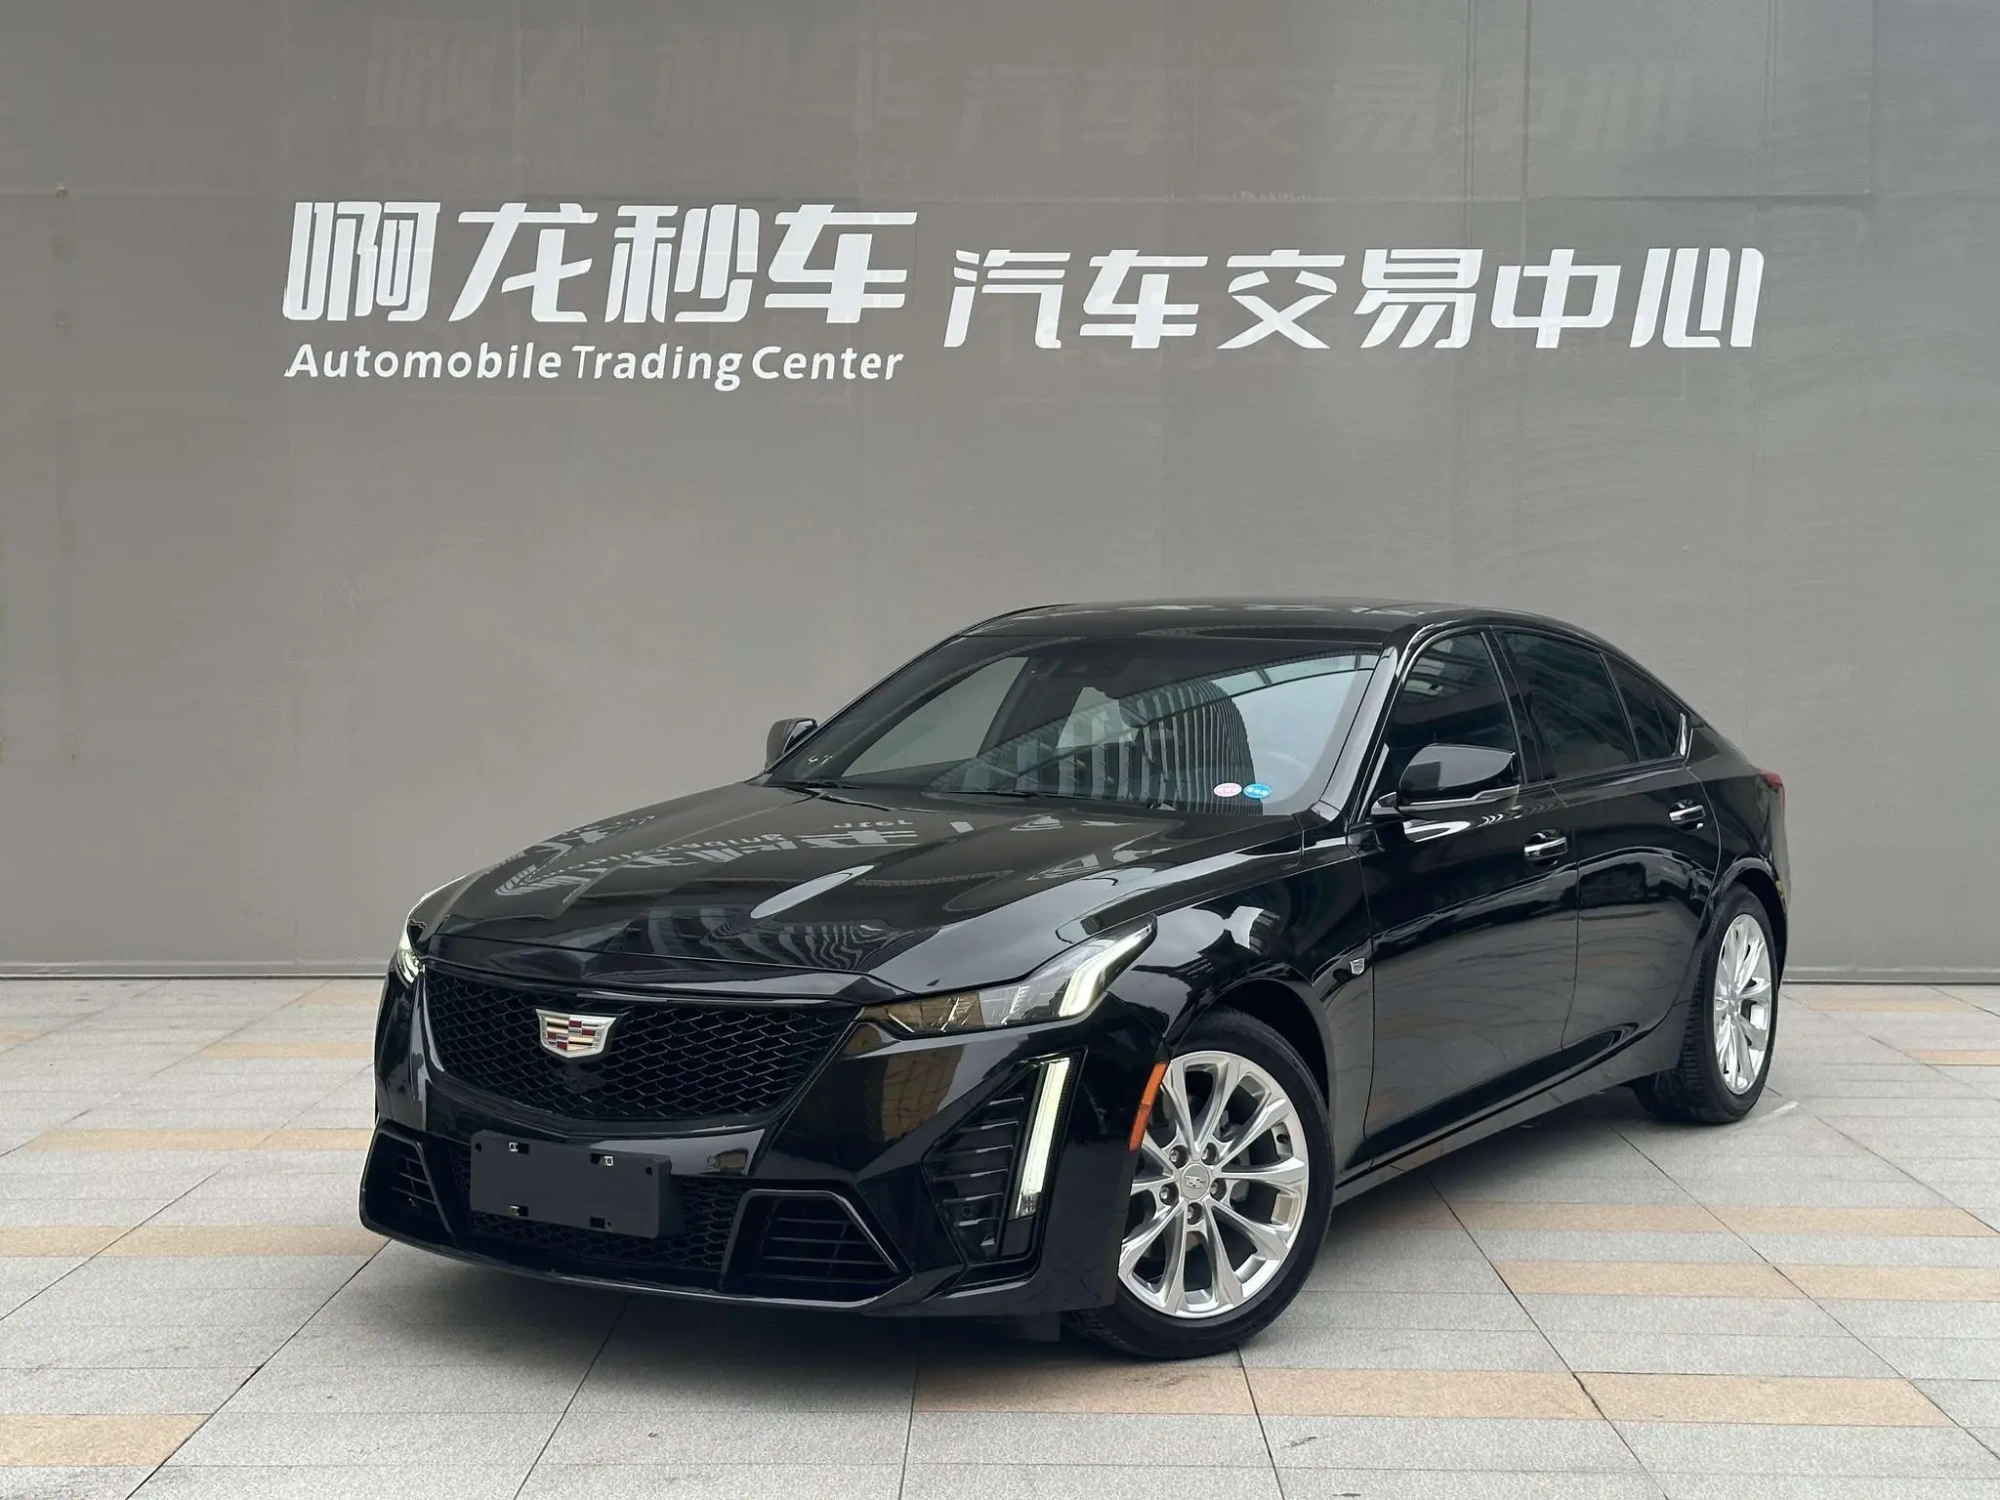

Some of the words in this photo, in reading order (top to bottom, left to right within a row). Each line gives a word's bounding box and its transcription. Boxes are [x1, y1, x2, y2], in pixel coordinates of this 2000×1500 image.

[283, 202, 917, 323] 啊龙秒车
[944, 248, 1764, 349] 汽车交易中心
[284, 342, 561, 380] Automobile
[572, 343, 743, 391] Trading
[752, 345, 904, 381] Center
